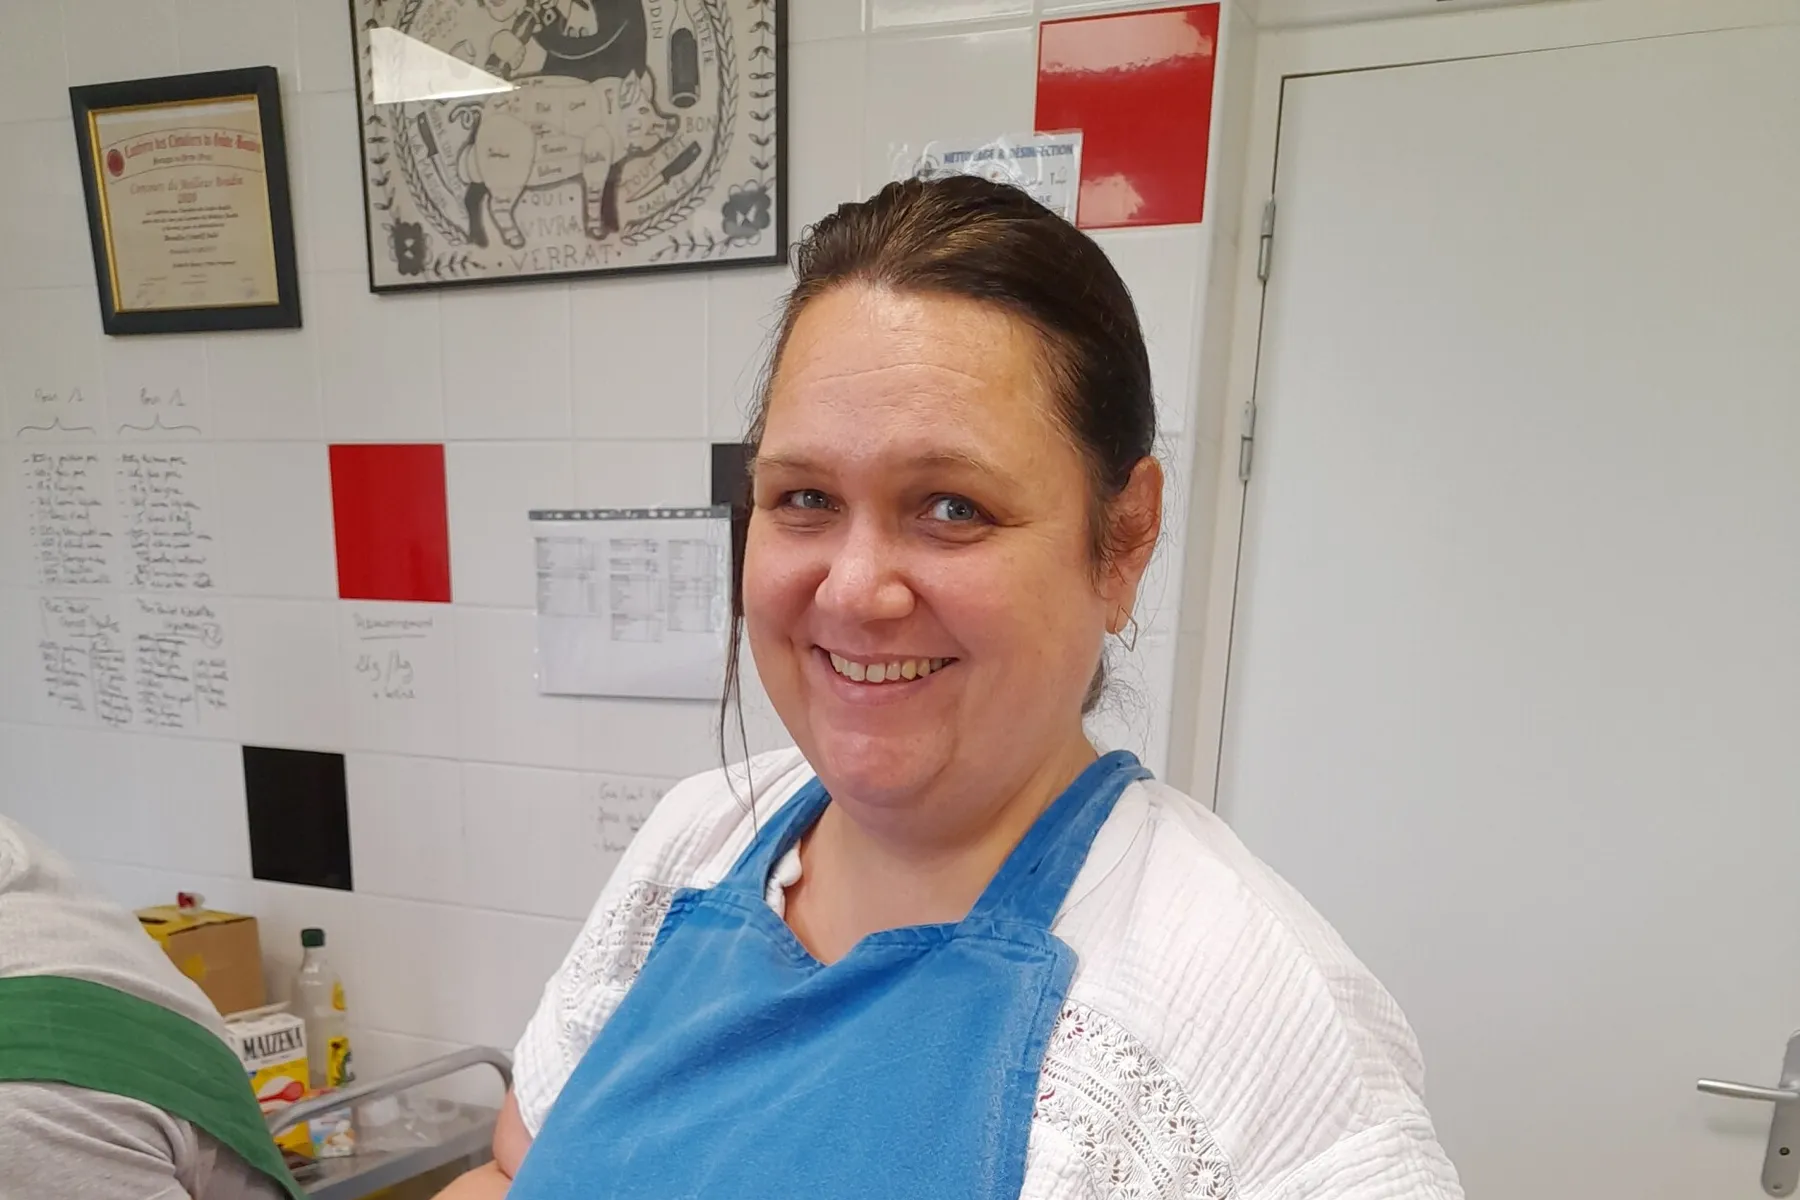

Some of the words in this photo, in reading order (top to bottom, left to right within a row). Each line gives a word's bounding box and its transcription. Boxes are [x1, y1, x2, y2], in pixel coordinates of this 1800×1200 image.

[619, 157, 661, 195] TOUT
[532, 193, 563, 206] QUI
[509, 244, 613, 271] VERRAT
[243, 1026, 303, 1061] MAIZENA
